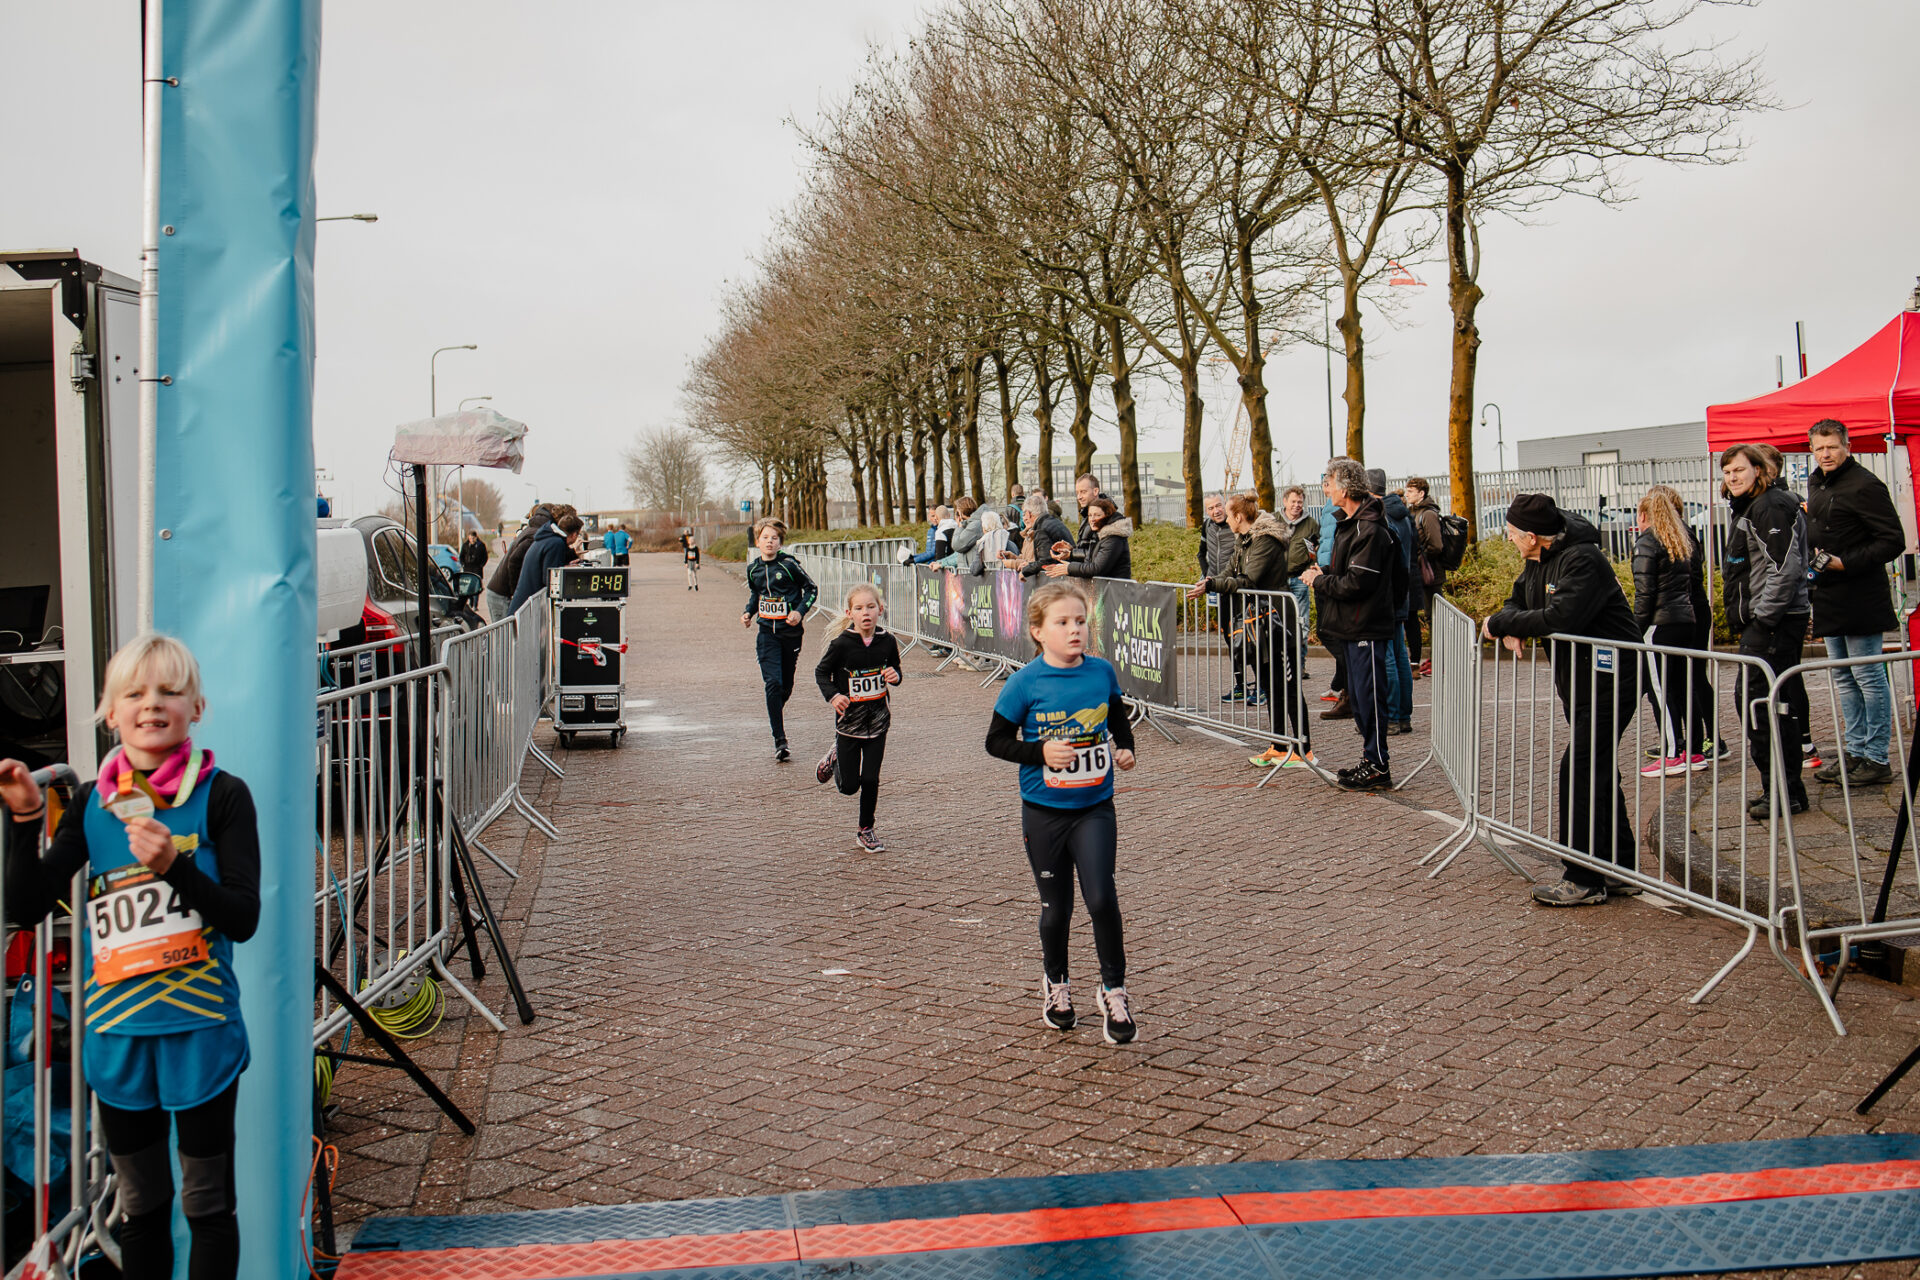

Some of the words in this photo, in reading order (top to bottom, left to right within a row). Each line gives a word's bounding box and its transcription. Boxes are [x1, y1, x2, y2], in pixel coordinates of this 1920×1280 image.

[978, 585, 993, 609] VALK
[759, 602, 785, 613] 5004
[1130, 603, 1163, 641] VALK
[1130, 637, 1163, 670] EVENT
[852, 675, 886, 693] 5019
[1130, 664, 1162, 684] PRODUCTIONS
[162, 945, 199, 965] 5024
